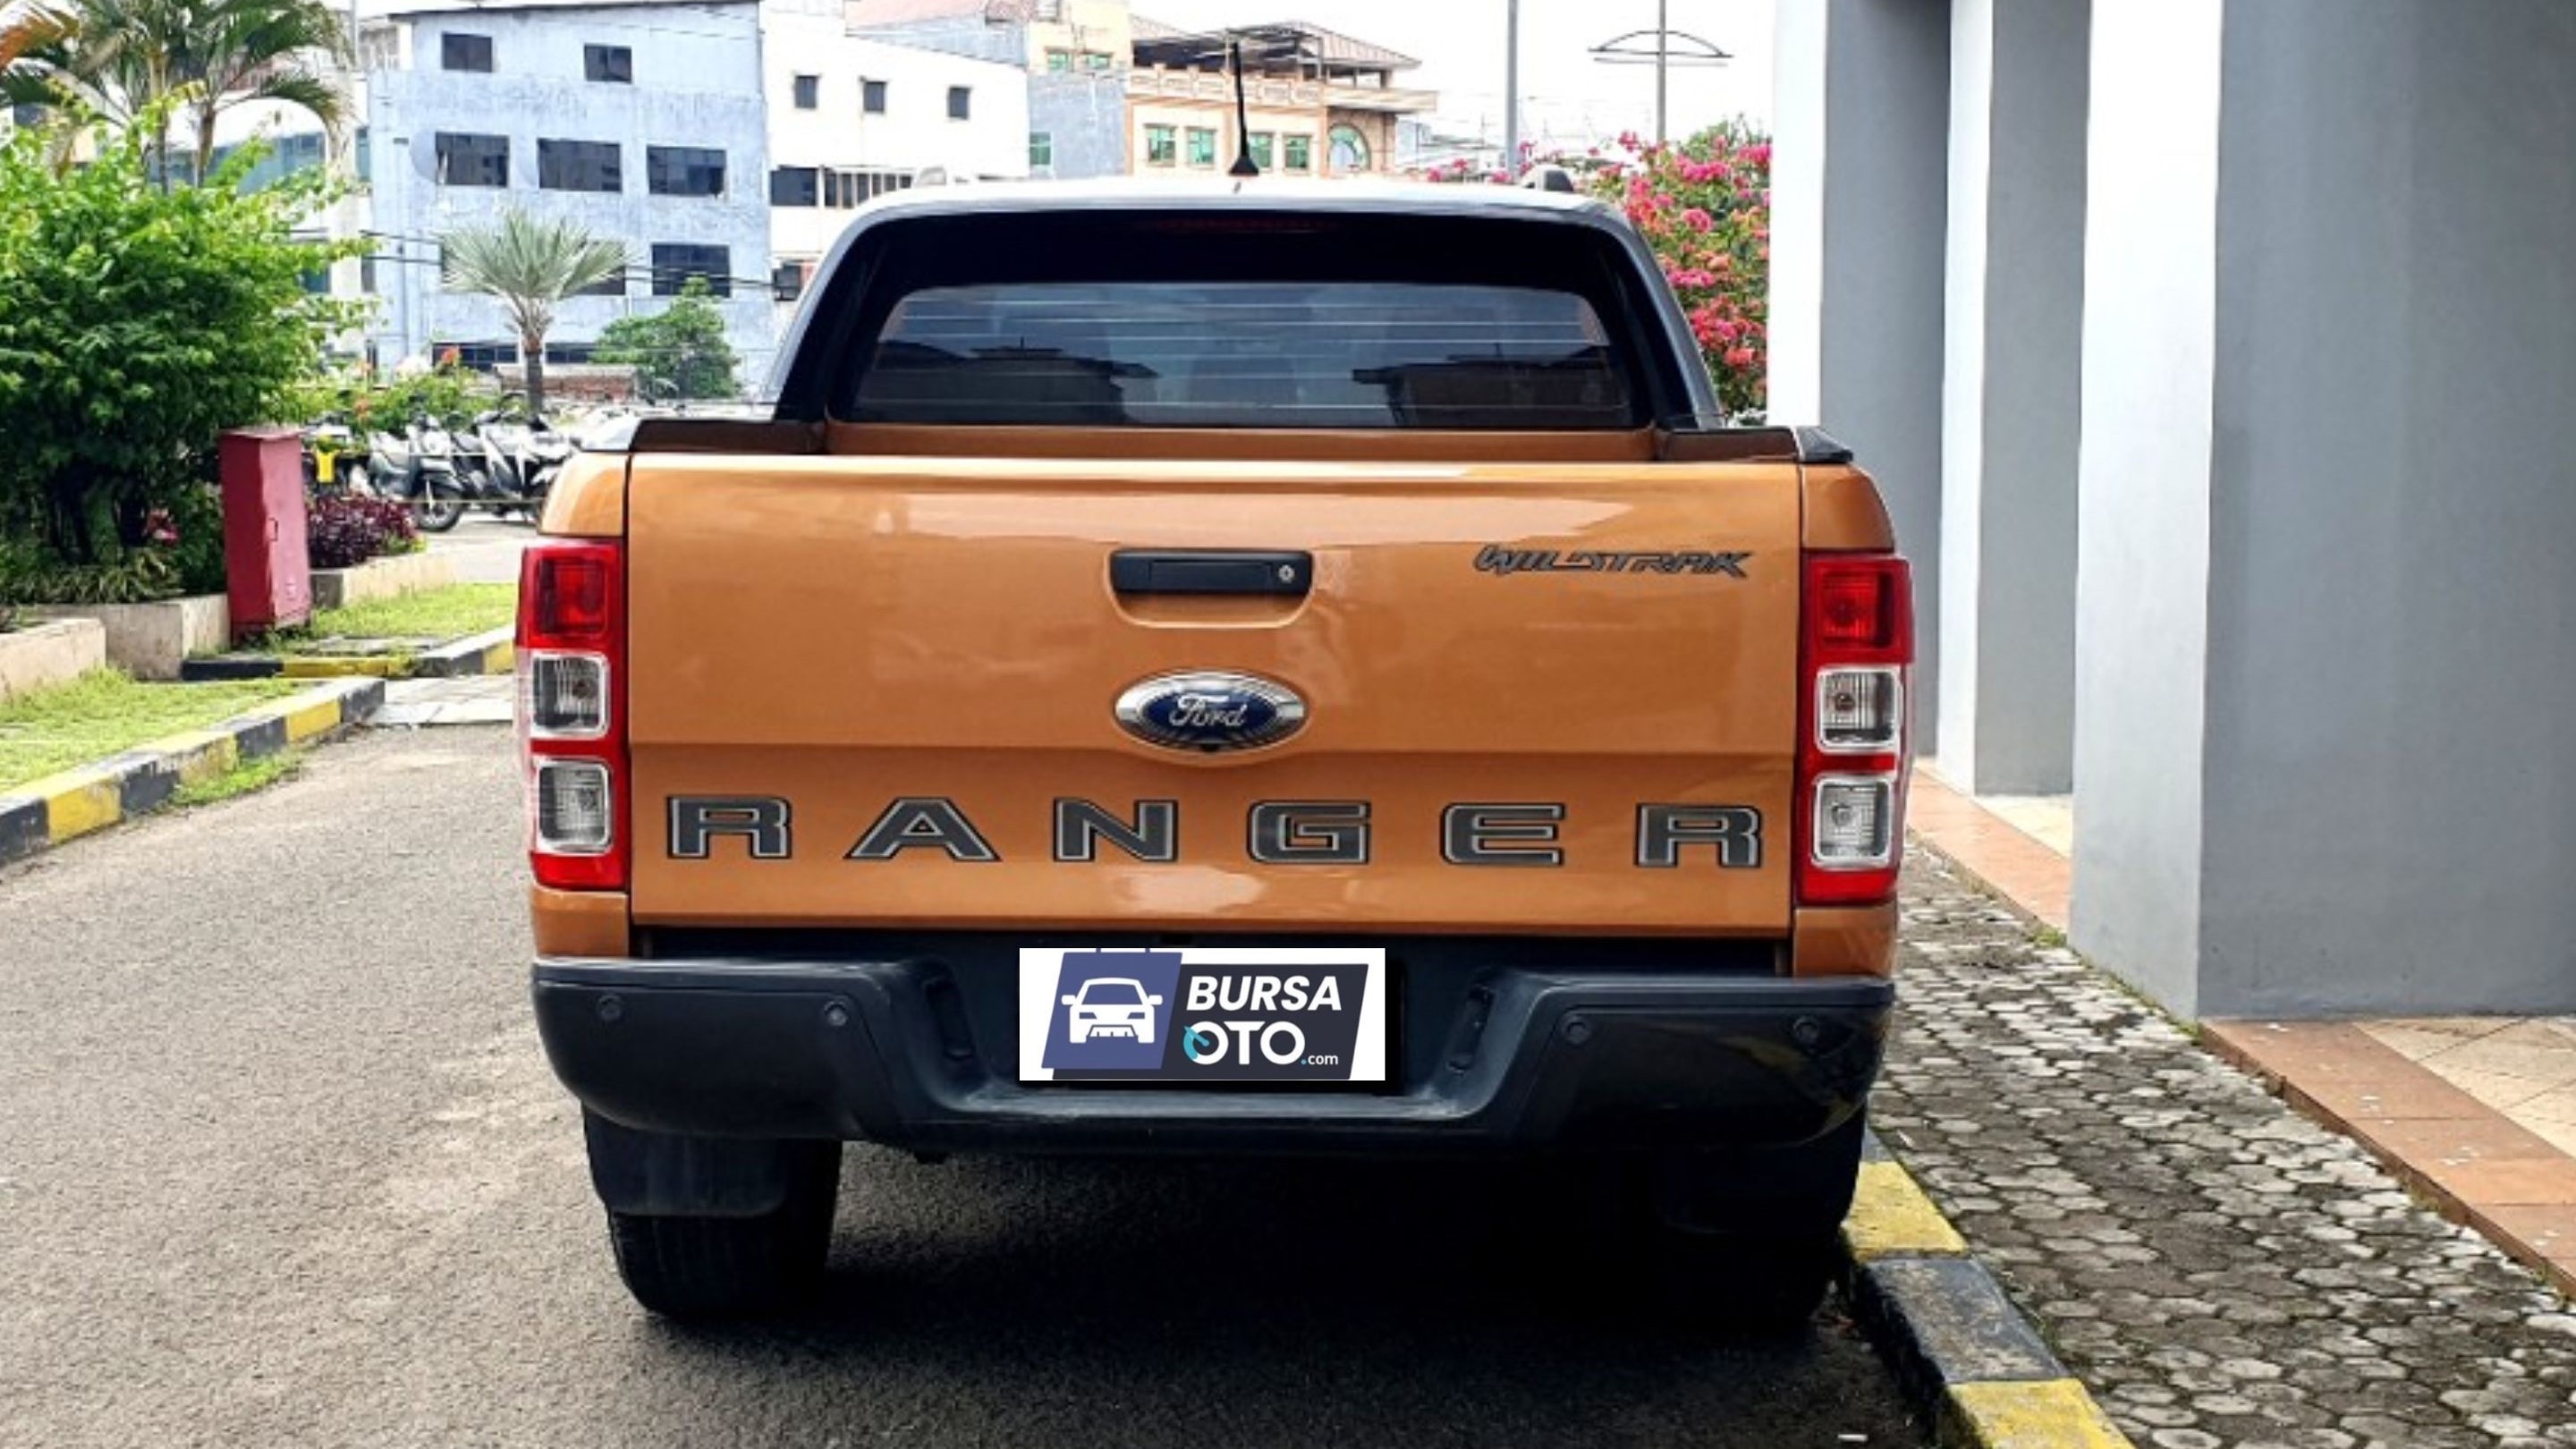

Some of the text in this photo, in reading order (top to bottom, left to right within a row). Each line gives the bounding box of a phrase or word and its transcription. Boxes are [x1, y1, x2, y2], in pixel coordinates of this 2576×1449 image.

[1474, 544, 1754, 580] WILDTRAK
[1168, 692, 1249, 727] Ford
[665, 795, 1763, 869] RANGER
